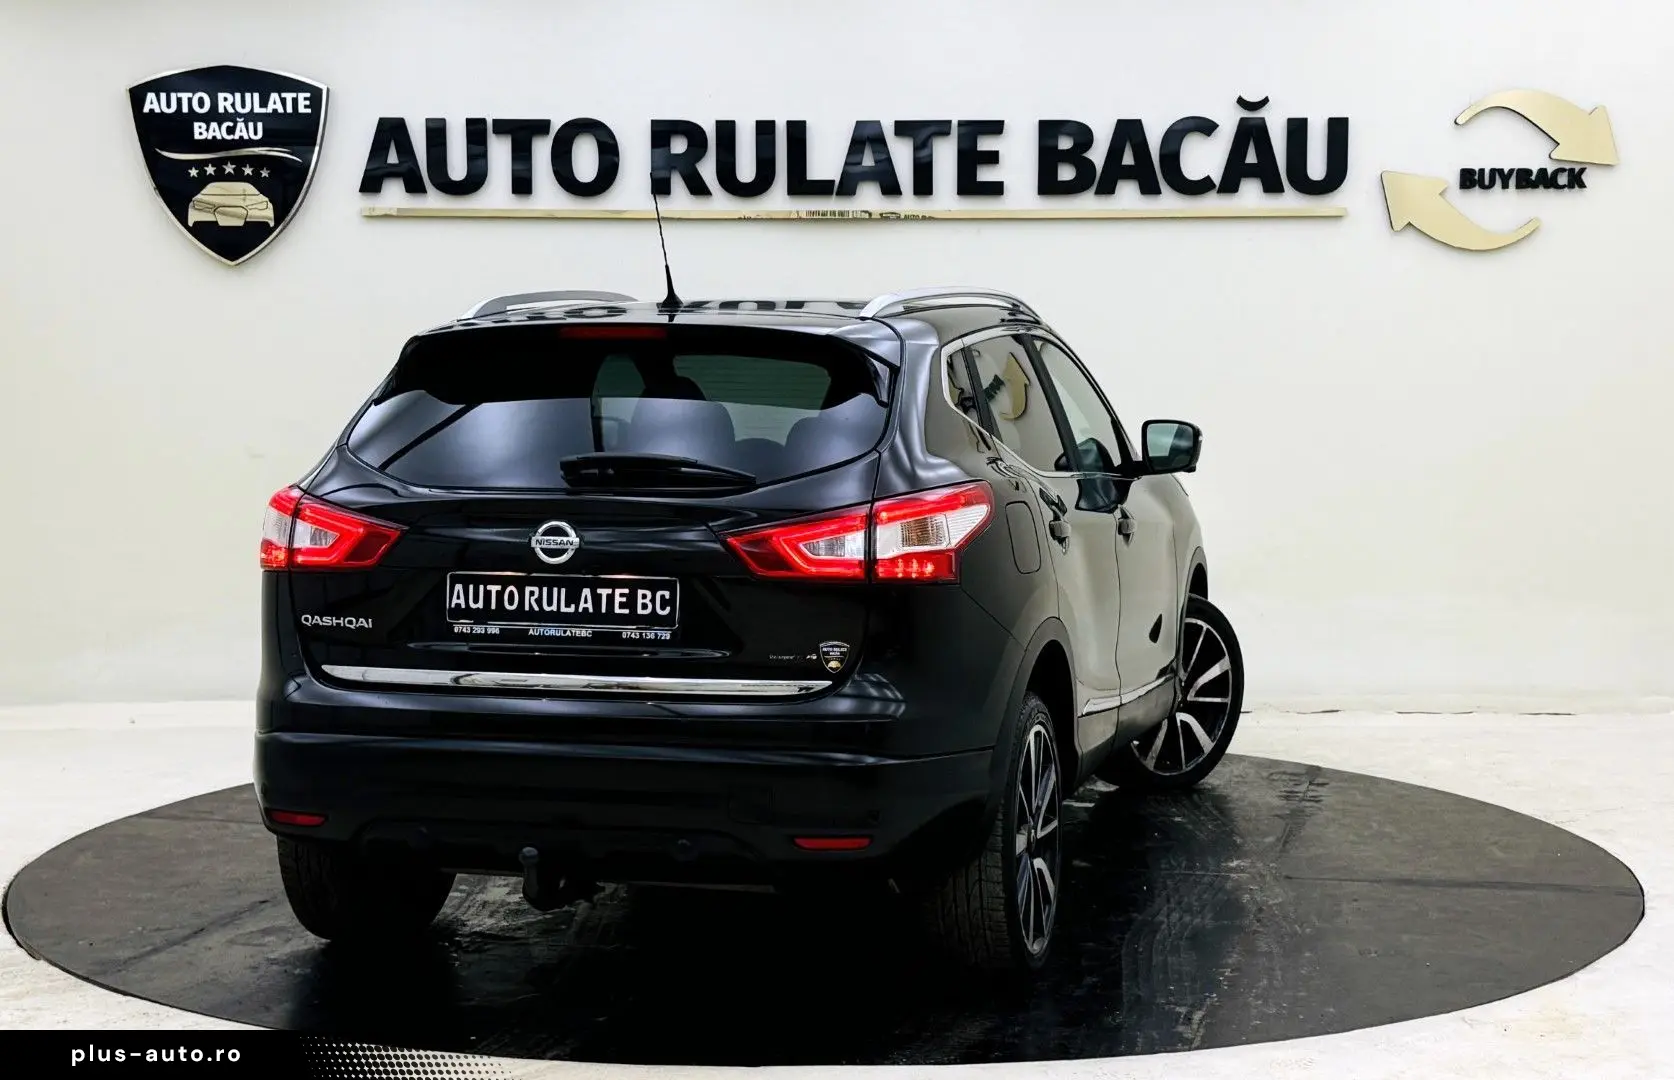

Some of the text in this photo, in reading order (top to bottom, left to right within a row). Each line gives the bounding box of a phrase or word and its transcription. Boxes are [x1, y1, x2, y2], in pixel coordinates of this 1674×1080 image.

[142, 92, 312, 114] AUTO RULATE
[193, 117, 264, 141] BACĂU
[359, 96, 1349, 198] AUTO RULATE BACĂU
[1459, 167, 1588, 190] BUYBACK
[535, 539, 574, 547] NISSAN
[450, 583, 671, 616] AUTO RULATE BC
[301, 614, 373, 629] QASHQAI
[454, 626, 471, 634] 0743
[528, 628, 593, 637] AUTORULATEBC
[622, 631, 640, 639] 0743
